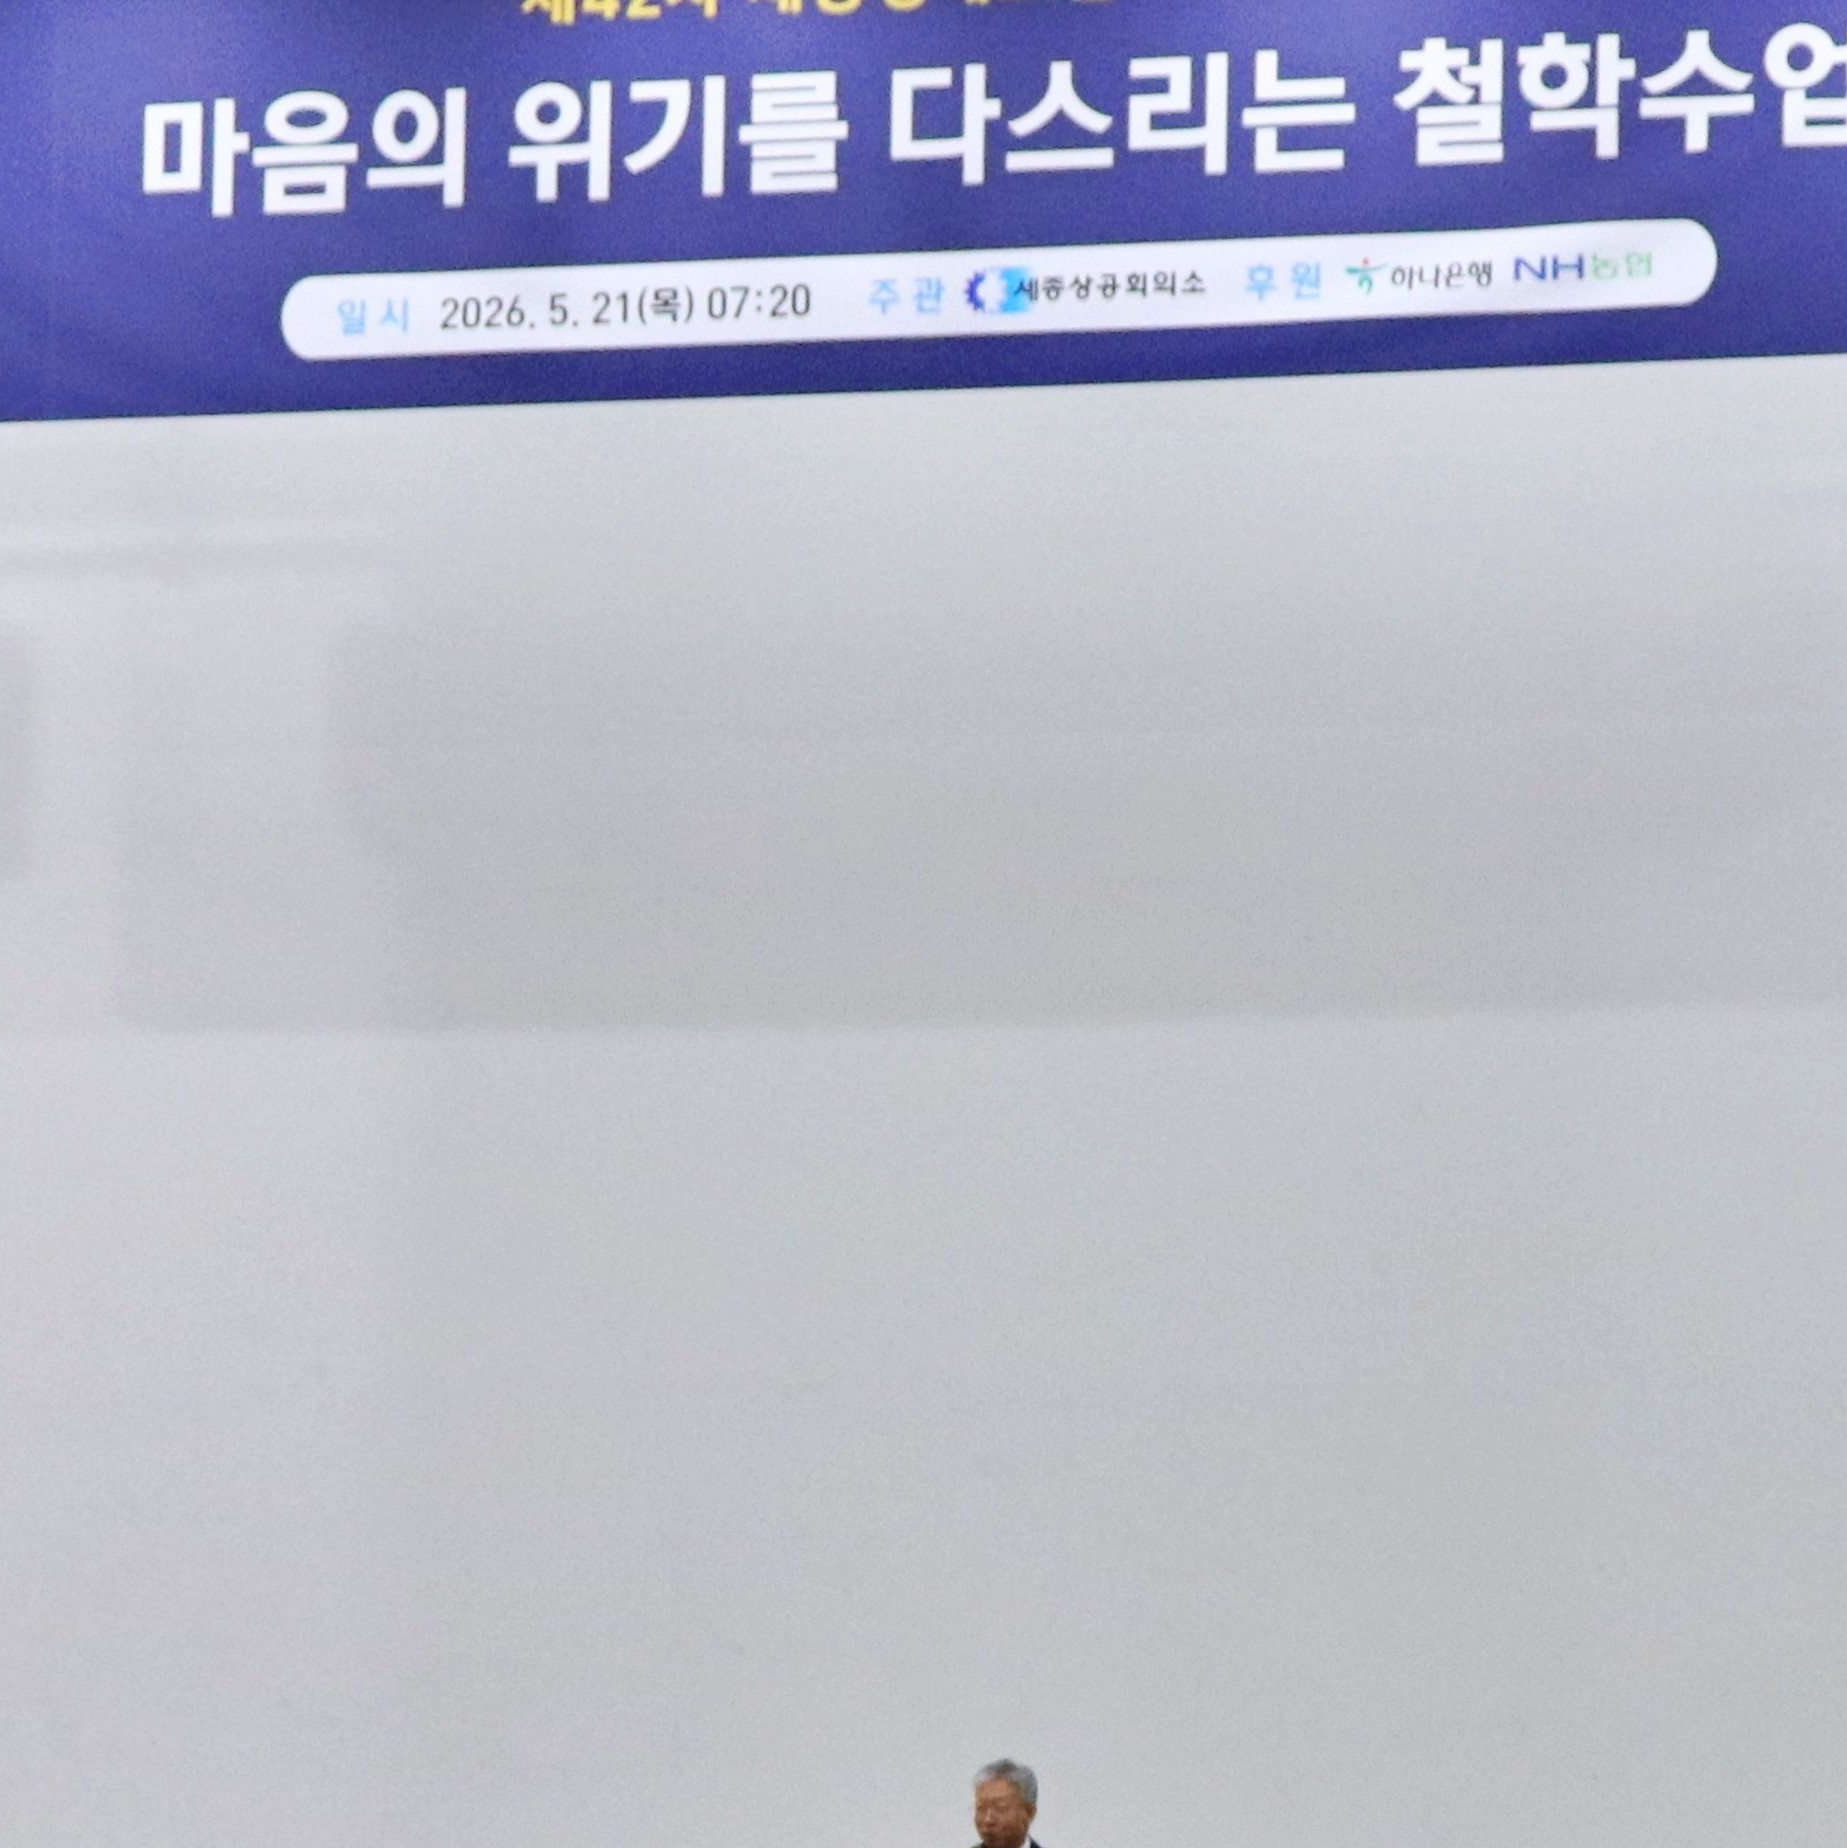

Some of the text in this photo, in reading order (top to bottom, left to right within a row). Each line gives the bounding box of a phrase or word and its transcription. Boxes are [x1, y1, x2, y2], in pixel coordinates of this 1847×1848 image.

[142, 87, 467, 218] 마음의
[508, 70, 850, 201] 위기를
[889, 49, 1357, 185] 다스리는
[439, 295, 536, 331] 2026.
[548, 292, 580, 328] 5.
[591, 287, 695, 326] 21(목)
[706, 283, 812, 321] 07:20
[1014, 270, 1208, 302] 세종상공회의소
